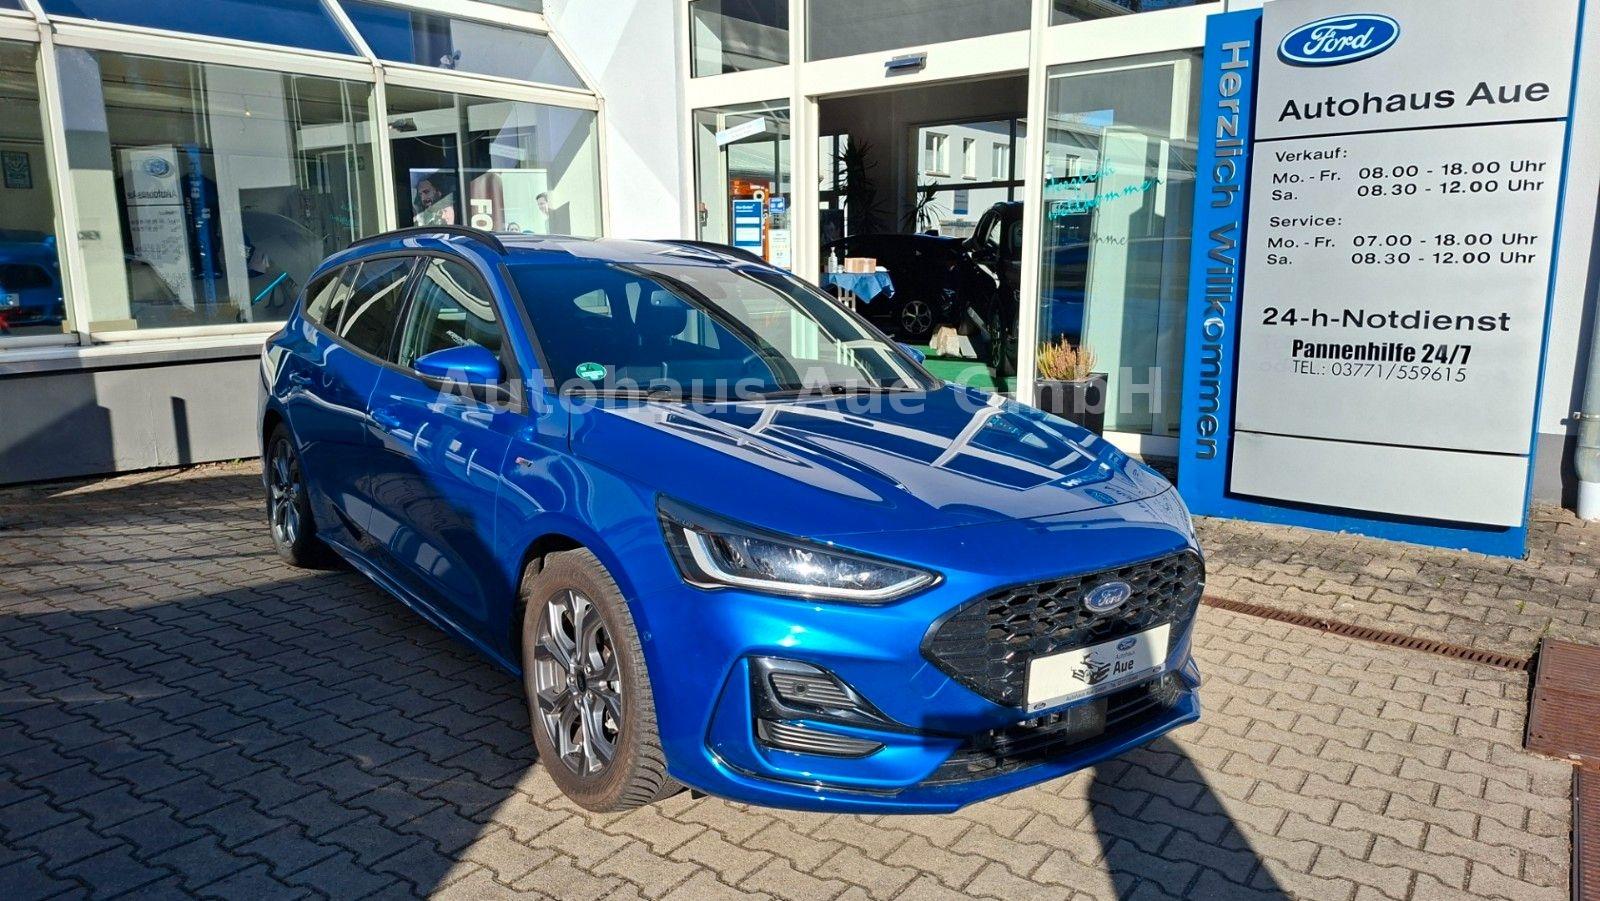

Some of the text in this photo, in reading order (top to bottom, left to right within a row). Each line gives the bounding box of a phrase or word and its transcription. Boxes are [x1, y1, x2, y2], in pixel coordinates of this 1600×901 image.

[1302, 22, 1374, 55] Ford
[1278, 81, 1550, 122] Autohaus Aue
[1212, 40, 1249, 207] Herzlich
[1275, 147, 1347, 162] Verkauf:
[1272, 172, 1304, 184] Mo.
[1320, 169, 1341, 181] Fr.
[1358, 165, 1419, 179] 08.00
[1441, 161, 1500, 175] 18.00
[1510, 160, 1546, 173] Uhr
[1271, 189, 1298, 201] Sa.
[1357, 183, 1417, 197] 08.30
[1439, 180, 1498, 194] 12.00
[1508, 179, 1544, 192] Uhr
[1269, 215, 1342, 227] Service:
[1267, 237, 1299, 248] Mo.
[1315, 236, 1335, 248] Fr.
[1353, 234, 1412, 247] 07.00
[1434, 233, 1492, 246] 18.00
[1502, 233, 1538, 245] Uhr
[1266, 253, 1292, 265] Sa.
[1351, 252, 1411, 264] 08.30
[1432, 252, 1491, 264] 12.00
[1500, 251, 1536, 264] Uhr
[1262, 307, 1511, 332] 24-h-Notdienst
[1194, 221, 1238, 460] Willkommen
[1291, 339, 1472, 366] Pannenhilfe 24/7
[1292, 360, 1467, 383] TEL.: 03771/559615
[1112, 659, 1134, 675] Aue
